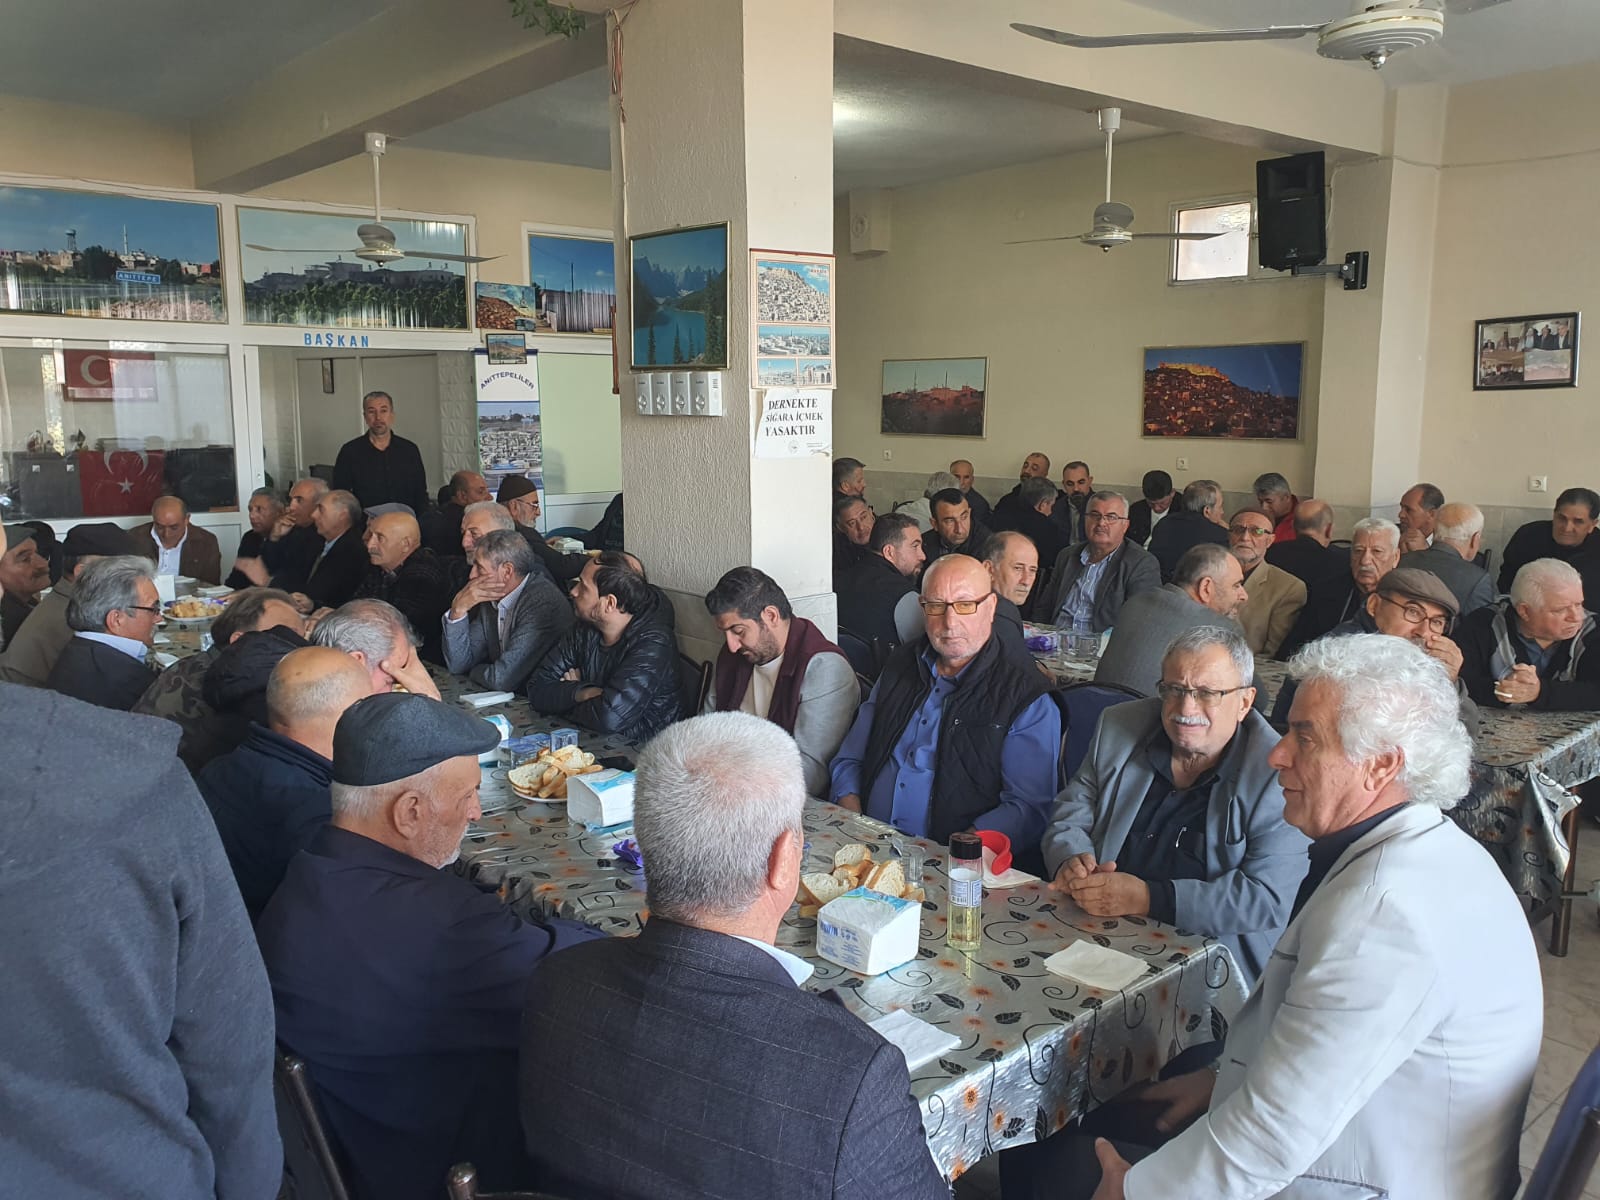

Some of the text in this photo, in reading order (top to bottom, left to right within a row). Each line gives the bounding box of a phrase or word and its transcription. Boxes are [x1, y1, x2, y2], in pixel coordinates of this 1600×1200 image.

[304, 332, 369, 348] BAŞKAN
[480, 371, 535, 390] ANITTEPELİLER
[768, 398, 818, 410] DERNEKTE
[796, 411, 823, 422] İÇMEK
[765, 425, 815, 437] YASAKTIR
